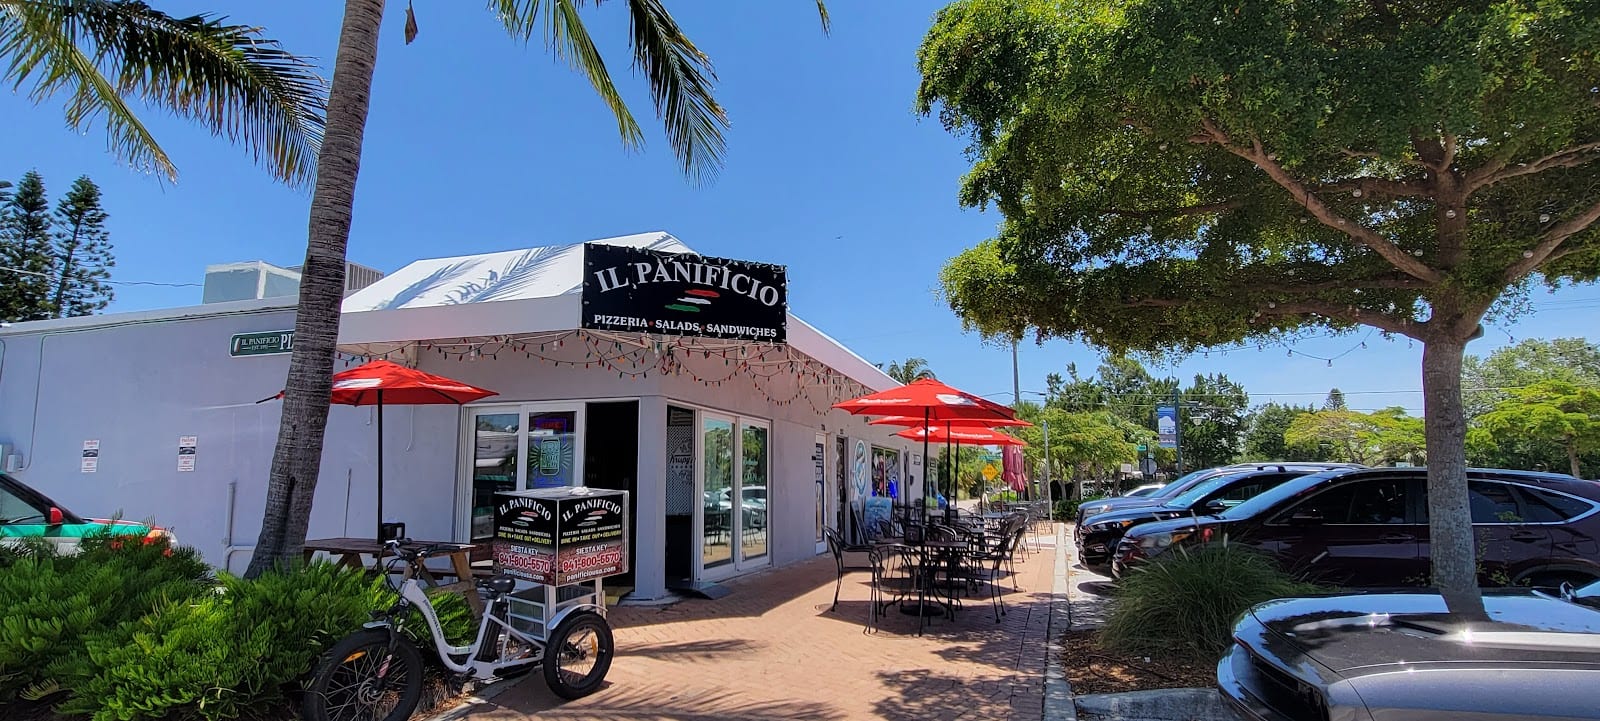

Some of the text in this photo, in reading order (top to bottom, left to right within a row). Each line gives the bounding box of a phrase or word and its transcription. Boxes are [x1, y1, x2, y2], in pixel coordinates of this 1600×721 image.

[593, 261, 779, 307] IL PANIFICIO
[594, 314, 777, 338] PIZZERIA SALADS SANDWICHES
[241, 336, 280, 346] IL PANIFICIO
[499, 497, 552, 521] IL PANIFICIO
[562, 498, 621, 522] IL PANIFICIO
[533, 537, 552, 545] DELIVERY
[576, 543, 608, 555] SIESTA KEY
[511, 545, 539, 556] SIESTA KEY
[566, 565, 617, 582] panificiousa.com
